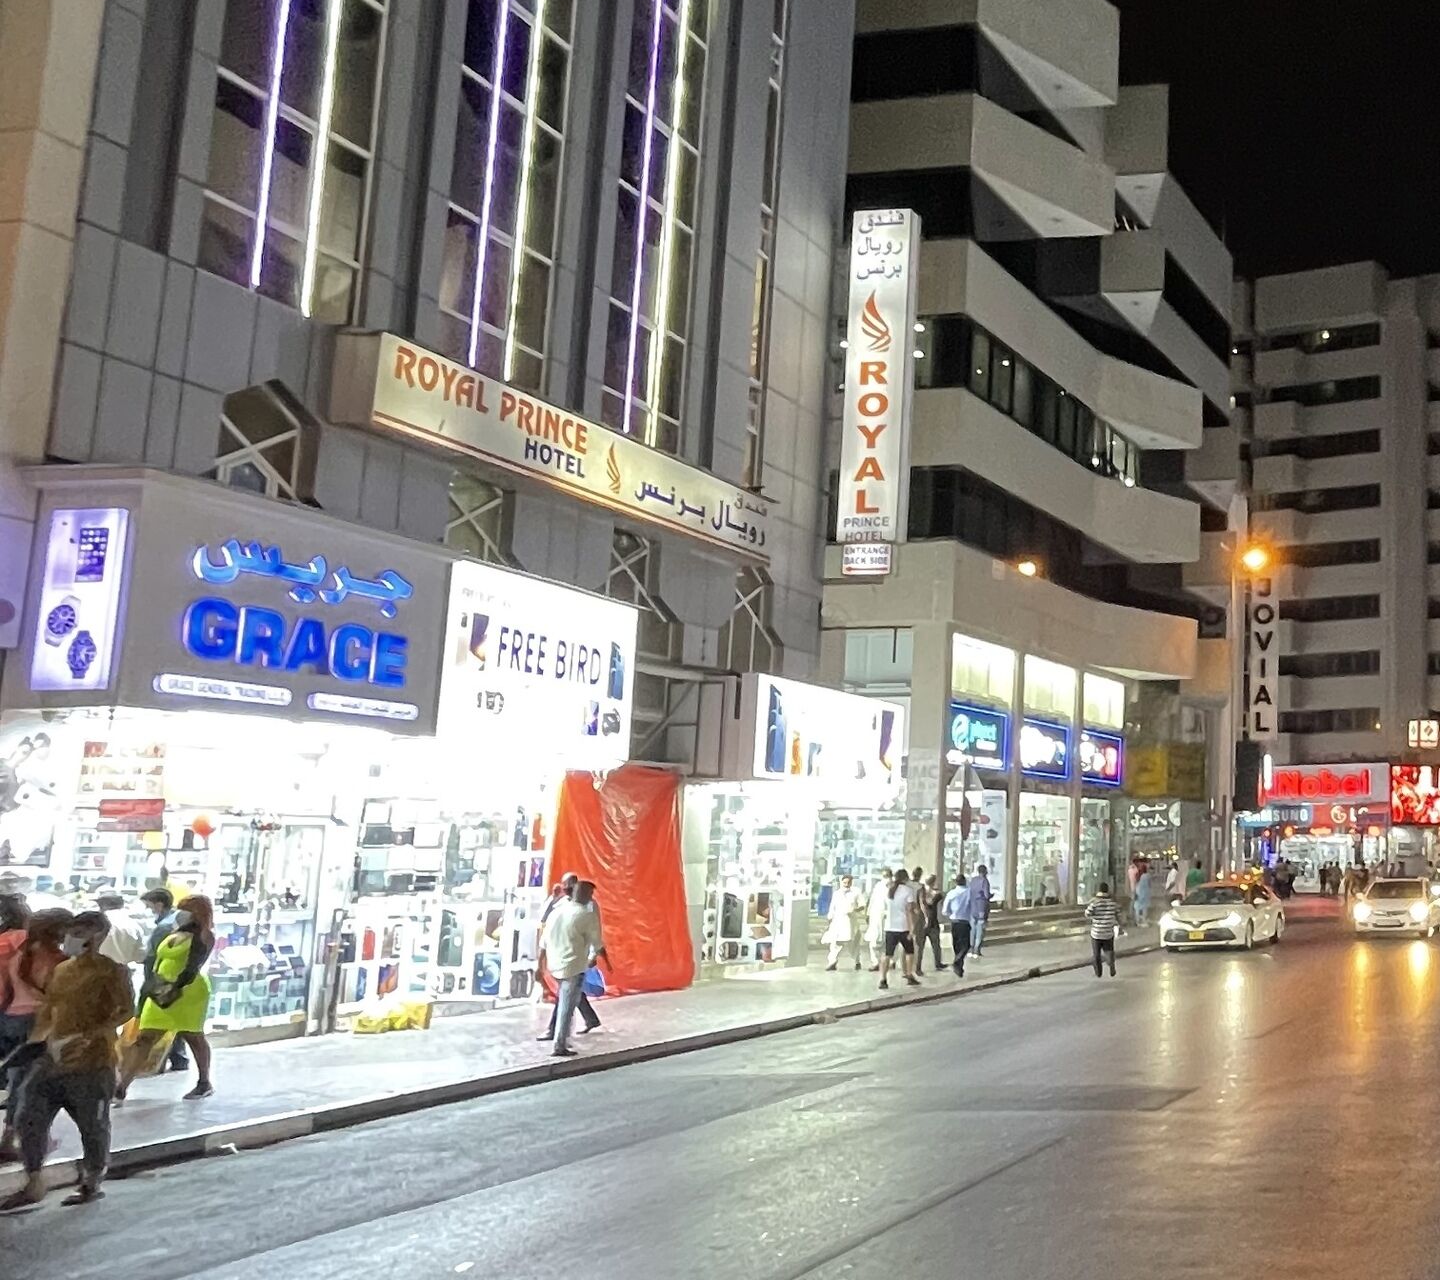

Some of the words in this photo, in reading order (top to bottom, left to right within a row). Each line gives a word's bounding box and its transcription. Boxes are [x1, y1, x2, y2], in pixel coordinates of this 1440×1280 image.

[858, 210, 905, 234] فندق
[857, 236, 903, 257] رويال
[856, 259, 903, 280] برنس
[395, 345, 489, 414] ROYAL
[499, 390, 589, 455] PRINCE
[523, 437, 586, 479] HOTEL
[853, 360, 889, 514] ROYAL
[634, 478, 706, 521] برنس
[711, 500, 766, 547] رويال
[843, 516, 890, 528] PRINCE
[844, 530, 887, 542] HOTEL
[844, 546, 890, 555] ENTRANCE
[192, 538, 414, 618] جريس
[182, 596, 409, 688] GRACE
[496, 625, 548, 676] FREE
[555, 639, 602, 685] BIRD
[1253, 578, 1275, 732] JOVIAL
[1267, 769, 1371, 800] Nobel
